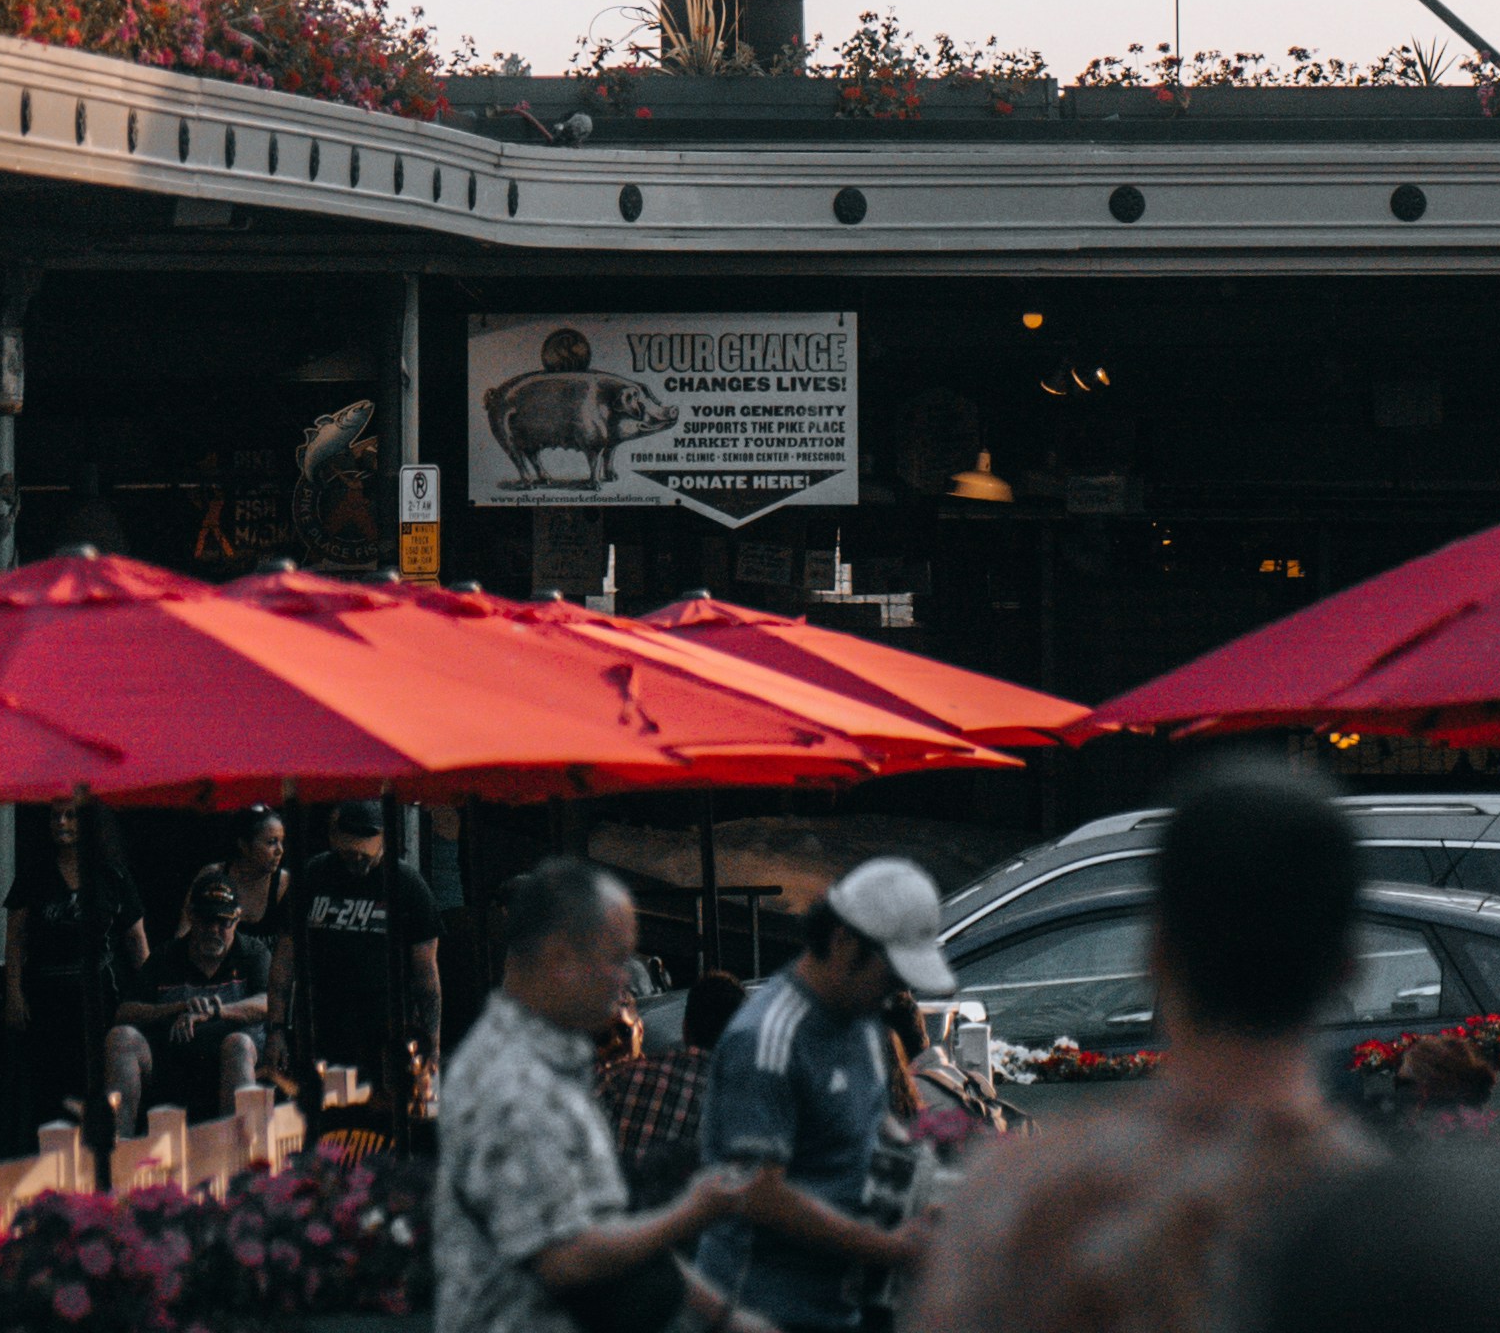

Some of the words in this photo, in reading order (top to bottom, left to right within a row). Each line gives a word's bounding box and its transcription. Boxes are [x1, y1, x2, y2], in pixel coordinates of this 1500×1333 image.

[627, 333, 715, 373] YOUR
[718, 333, 848, 373] CHANGE
[664, 376, 771, 393] CHANGES
[776, 376, 848, 393] LIVES!
[691, 405, 736, 417] YOUR
[740, 405, 847, 417] GENEROSITY
[683, 421, 747, 434] SUPPORTS
[751, 421, 773, 434] THE
[777, 421, 805, 434] PIKE
[808, 421, 846, 434] PLACE
[673, 437, 739, 448] MARKET
[744, 437, 846, 448] FOUNDATION
[631, 452, 654, 463] FOOD
[656, 452, 679, 463] BANK
[686, 452, 716, 463] CLINIC
[722, 452, 754, 463] SENIOR
[756, 452, 790, 463] CENTER
[796, 452, 846, 463] PRESCHOOL
[668, 475, 747, 489] DONATE
[752, 475, 810, 489] HERE!
